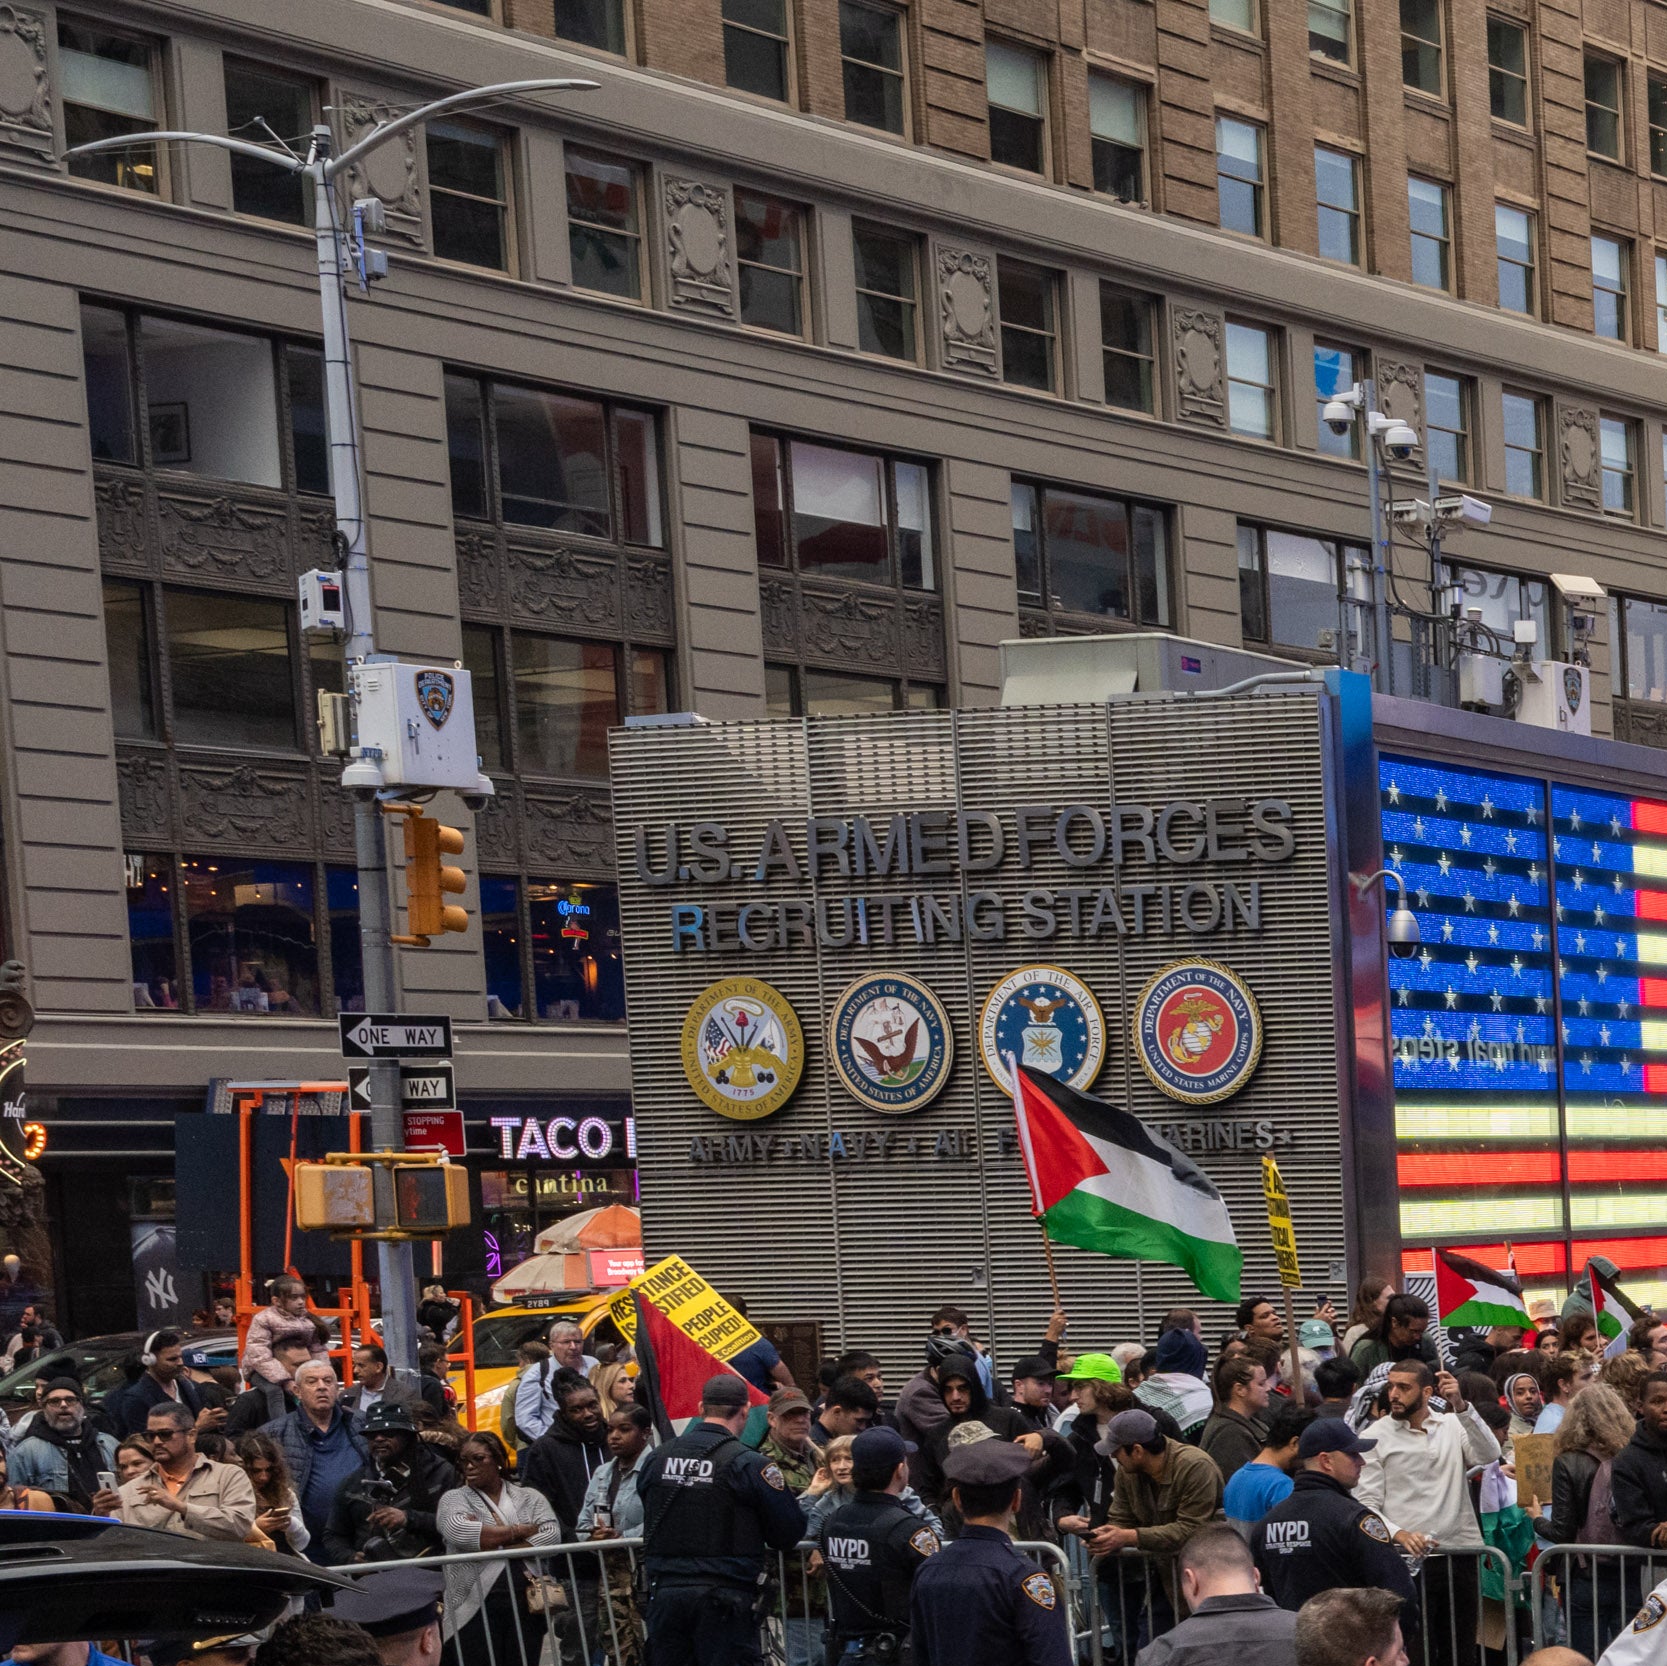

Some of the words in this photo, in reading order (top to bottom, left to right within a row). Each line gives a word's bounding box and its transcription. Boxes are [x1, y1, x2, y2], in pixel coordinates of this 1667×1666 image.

[634, 823, 741, 886] U.S.
[755, 810, 998, 881] ARMED
[1016, 801, 1296, 867] FORCES
[672, 889, 1001, 951] RECRUITING
[1022, 881, 1261, 938] STATION
[359, 1028, 390, 1044] ONE
[405, 1028, 437, 1045] WAY
[408, 1080, 440, 1096] WAY
[408, 1116, 444, 1125] STOPPING
[490, 1117, 612, 1159] TACO
[682, 1301, 730, 1336] PEOPLE
[1265, 1520, 1308, 1543] NYPD
[828, 1536, 869, 1559] NYPD
